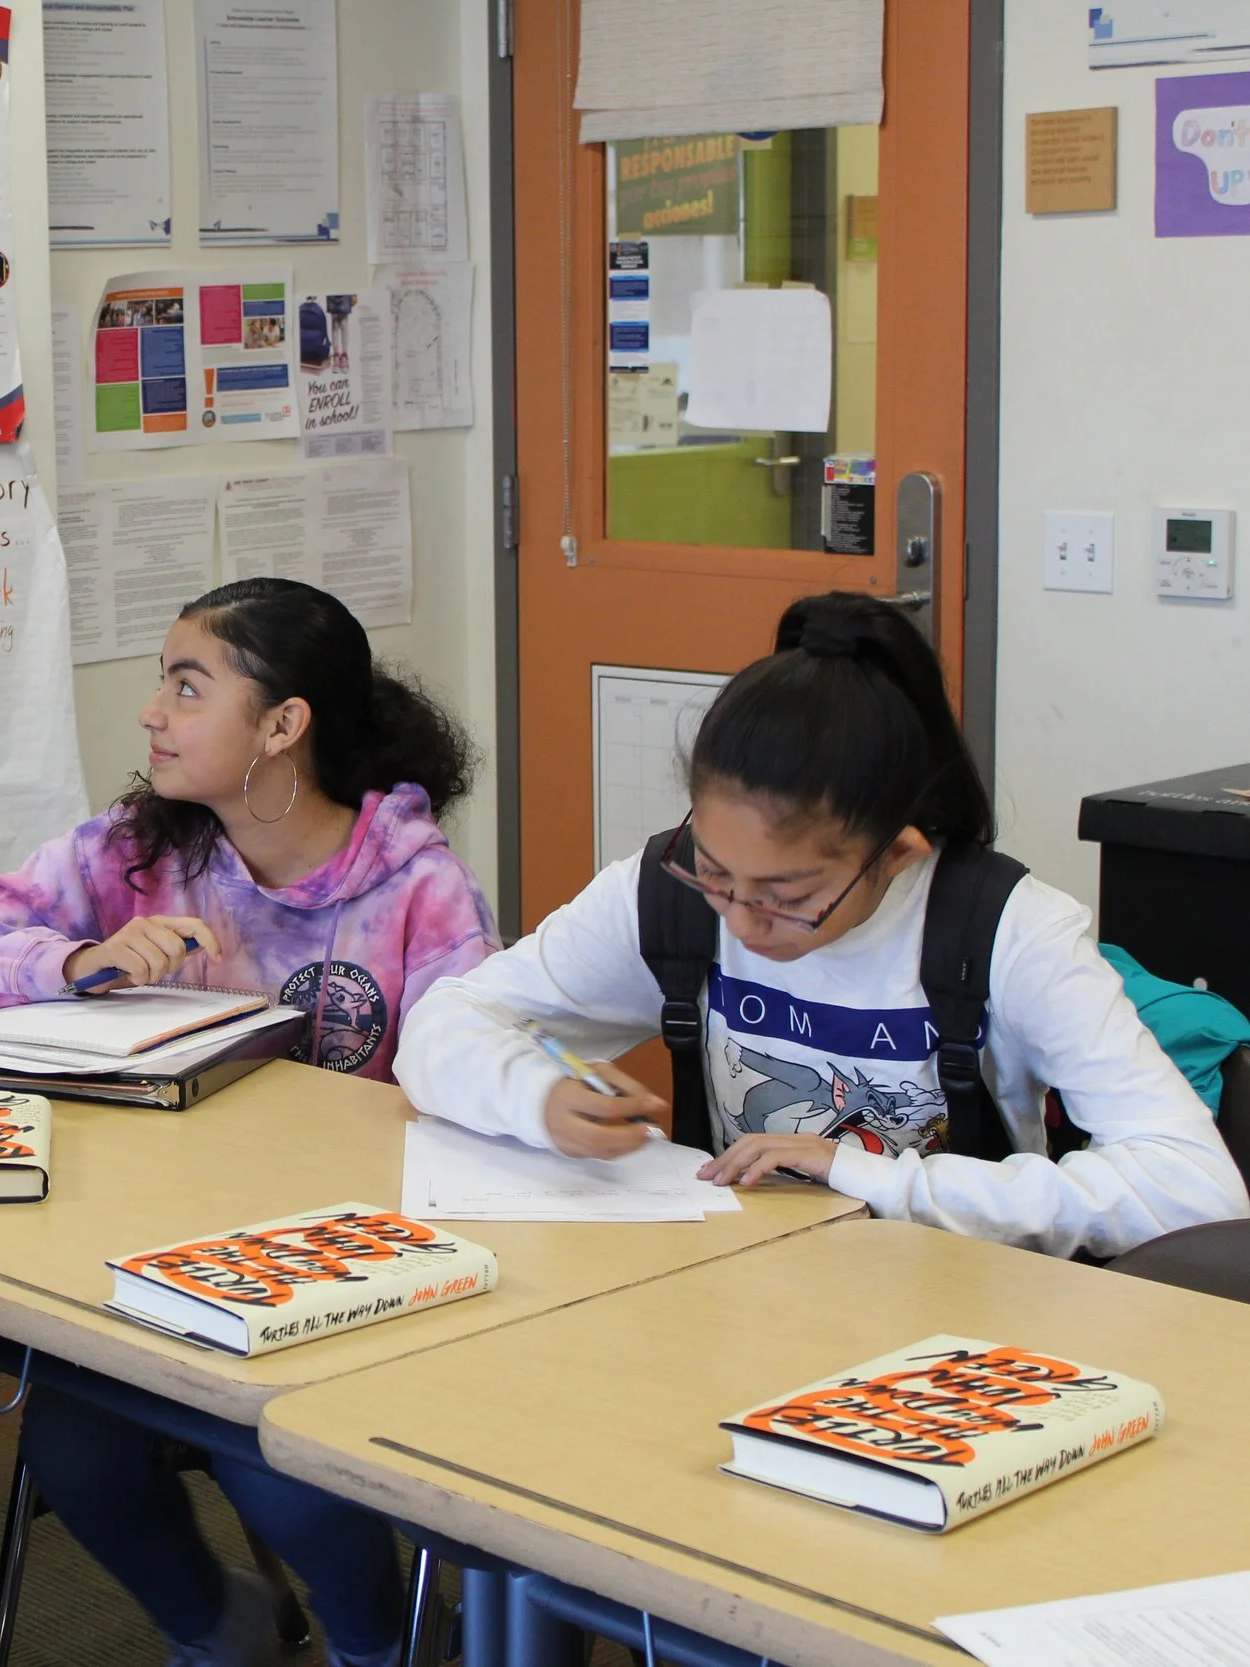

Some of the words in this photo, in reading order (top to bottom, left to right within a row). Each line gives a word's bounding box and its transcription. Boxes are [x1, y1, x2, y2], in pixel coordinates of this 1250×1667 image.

[308, 381, 327, 395] You
[330, 379, 349, 390] can
[308, 392, 351, 413] ENROLL
[305, 416, 317, 430] in
[319, 404, 360, 426] school!
[282, 966, 316, 1003] PROTECT
[349, 968, 380, 1003] OCEANS
[323, 1023, 381, 1072] INHABITANTS
[280, 1226, 403, 1261] JOHN
[299, 1212, 458, 1254] GREEN
[132, 1253, 288, 1308] TURTLES
[260, 1321, 300, 1344] TURTLES
[302, 1315, 323, 1335] ALL
[323, 1310, 345, 1329] THE
[347, 1303, 372, 1323] WAY
[374, 1295, 404, 1316] DOWN
[408, 1284, 438, 1306] JOHN
[441, 1272, 478, 1298] GREEN
[893, 1368, 1062, 1407] JOHN
[906, 1350, 1118, 1391] GREEN
[750, 1405, 968, 1468] TURTLES
[956, 1481, 992, 1512] TURTLES
[995, 1474, 1012, 1498] ALL
[1013, 1468, 1033, 1489] THE
[1034, 1456, 1056, 1481] WAY
[1058, 1444, 1085, 1470] DOWN
[1089, 1427, 1115, 1457] JOHN
[1117, 1411, 1151, 1445] GREEN
